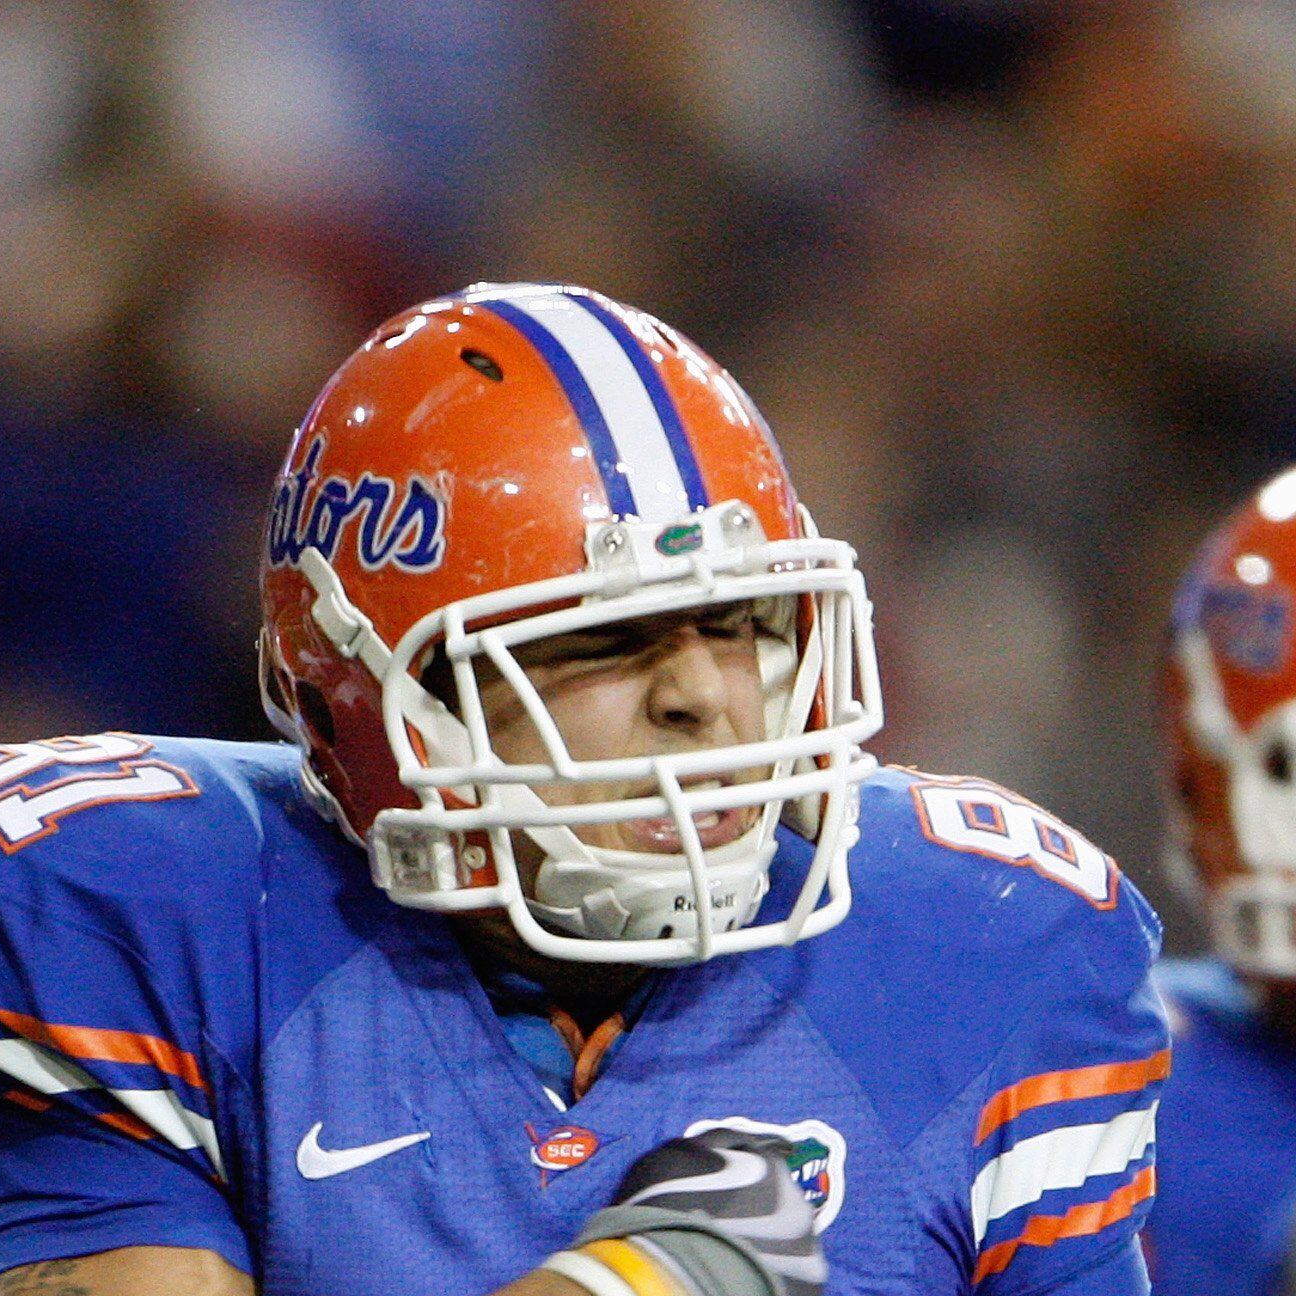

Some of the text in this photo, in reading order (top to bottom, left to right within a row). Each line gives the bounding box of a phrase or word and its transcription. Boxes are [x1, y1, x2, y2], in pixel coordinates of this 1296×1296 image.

[266, 432, 447, 575] ators
[884, 763, 1121, 912] 8
[546, 1142, 586, 1159] SEC
